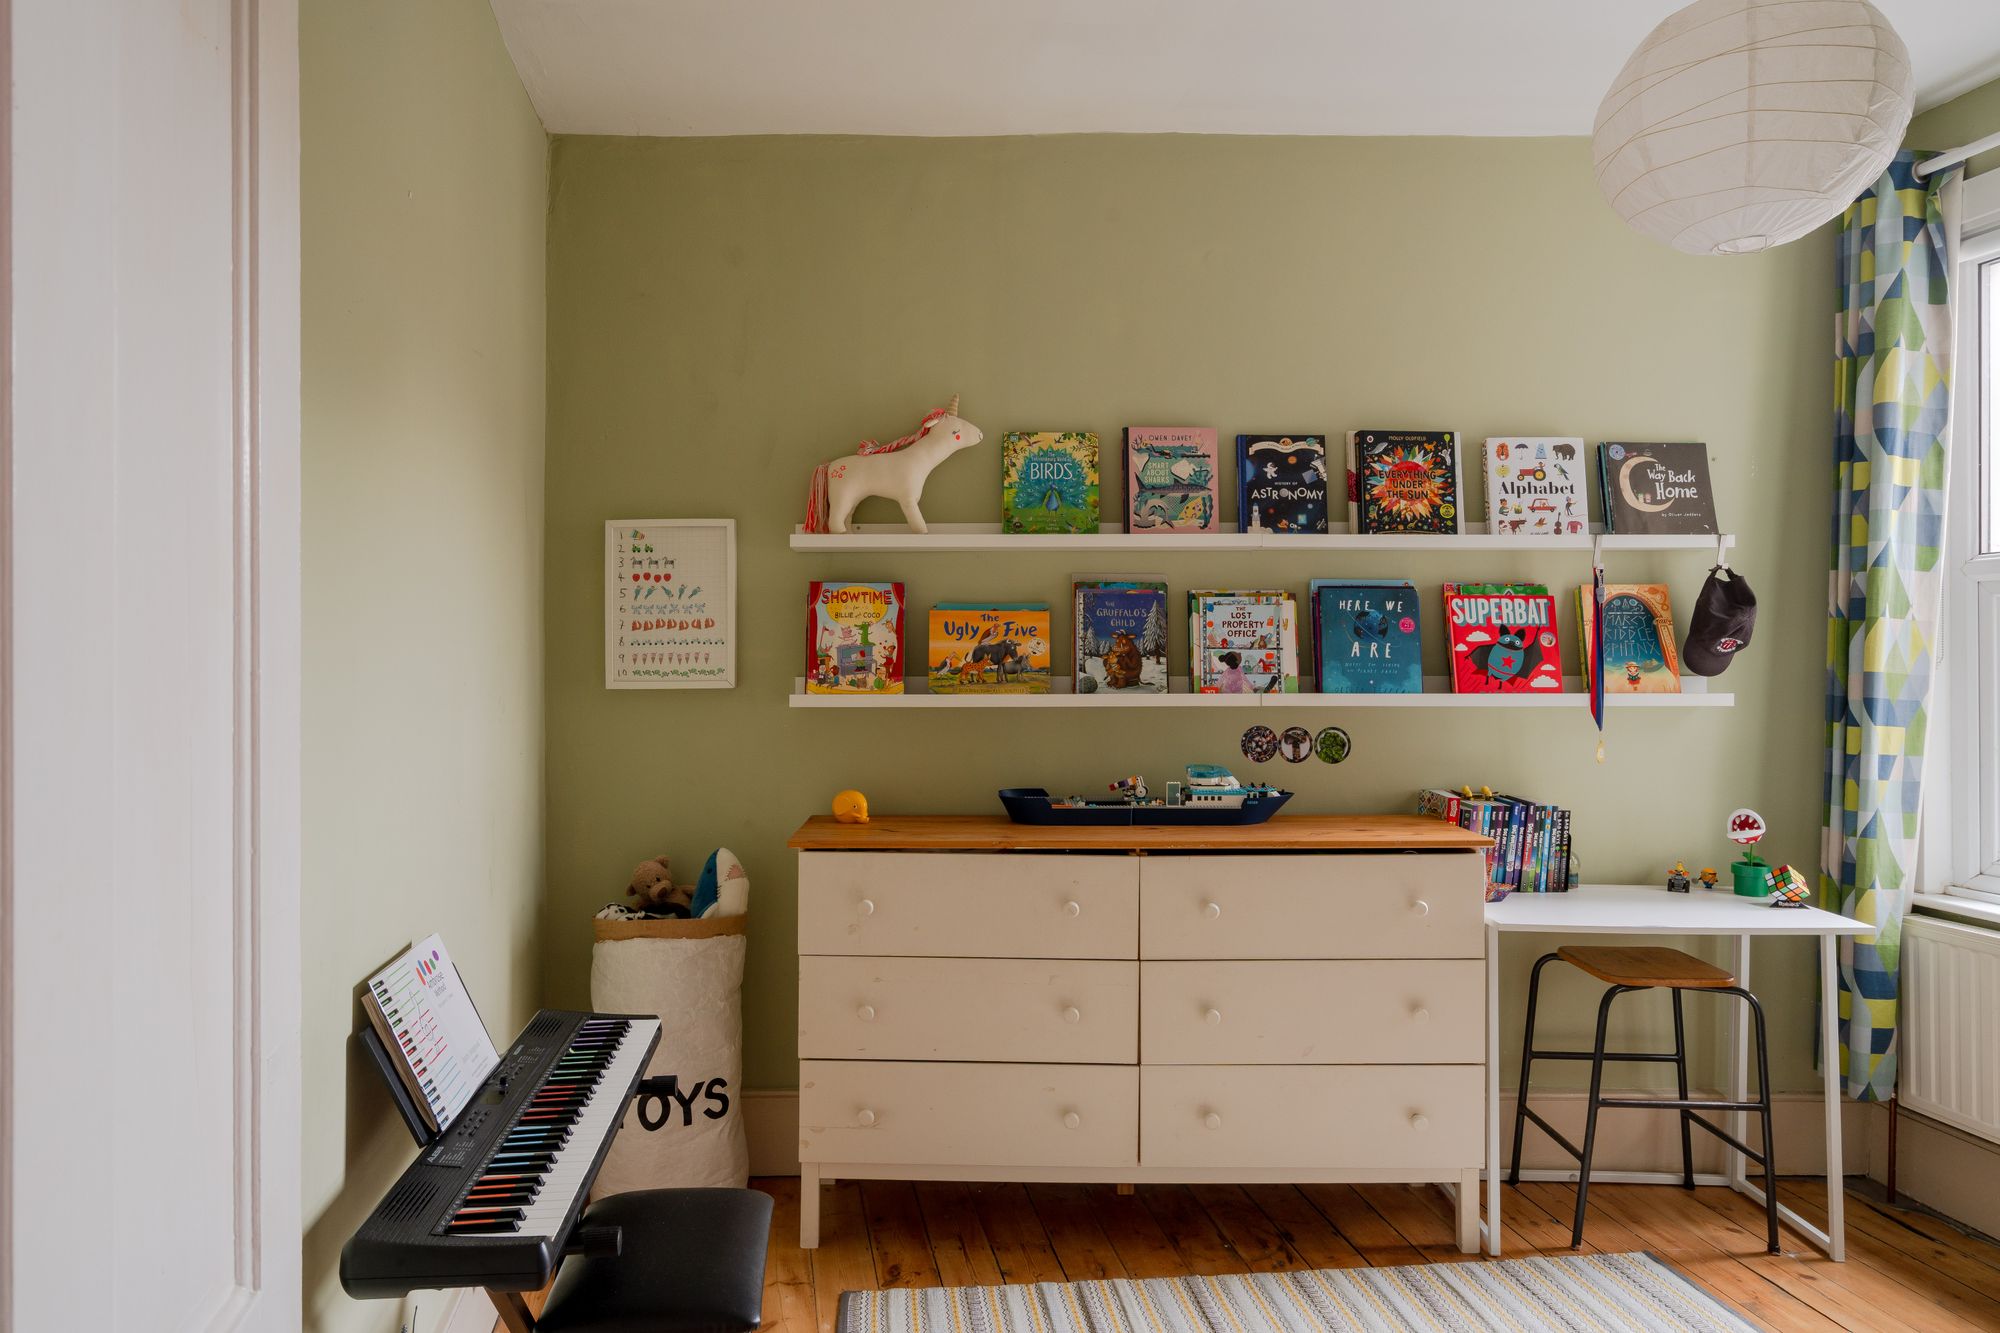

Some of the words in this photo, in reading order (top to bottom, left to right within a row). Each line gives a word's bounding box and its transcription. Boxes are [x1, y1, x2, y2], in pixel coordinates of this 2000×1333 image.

[1030, 462, 1073, 480] BIRDS
[1654, 463, 1666, 472] The
[1144, 476, 1170, 484] SHARKS
[1379, 470, 1437, 480] EVERYTHING
[1647, 469, 1666, 482] Way
[1668, 470, 1696, 483] Back
[1392, 480, 1423, 489] UNDER
[1498, 481, 1575, 498] Alphabet
[1251, 487, 1324, 500] ASTRONOMY
[1387, 490, 1404, 499] THE
[1407, 490, 1429, 499] SUN
[1655, 482, 1699, 500] Home
[618, 545, 625, 553] 2
[618, 557, 625, 568] 3
[618, 573, 625, 582] 4
[619, 588, 627, 599] 5
[821, 588, 893, 605] SHOWTIME
[619, 605, 626, 614] 6
[1339, 600, 1370, 611] HERE
[1385, 600, 1404, 612] WE
[834, 611, 854, 619] BILLIE
[863, 611, 881, 619] COCO
[1096, 608, 1147, 617] GRUFFALO'S
[1451, 598, 1549, 625] SUPERBAT
[980, 613, 1000, 622] The
[1604, 614, 1647, 627] MARCY
[619, 620, 625, 630] 7
[1110, 619, 1136, 627] CHILD
[1222, 620, 1265, 629] PROPERTY
[943, 621, 980, 641] Ugly
[1002, 621, 1038, 637] Five
[1227, 629, 1257, 638] OFFICE
[618, 636, 625, 647] 8
[1351, 641, 1392, 658] ARE
[618, 653, 625, 663] 9
[619, 1078, 730, 1132] OYS
